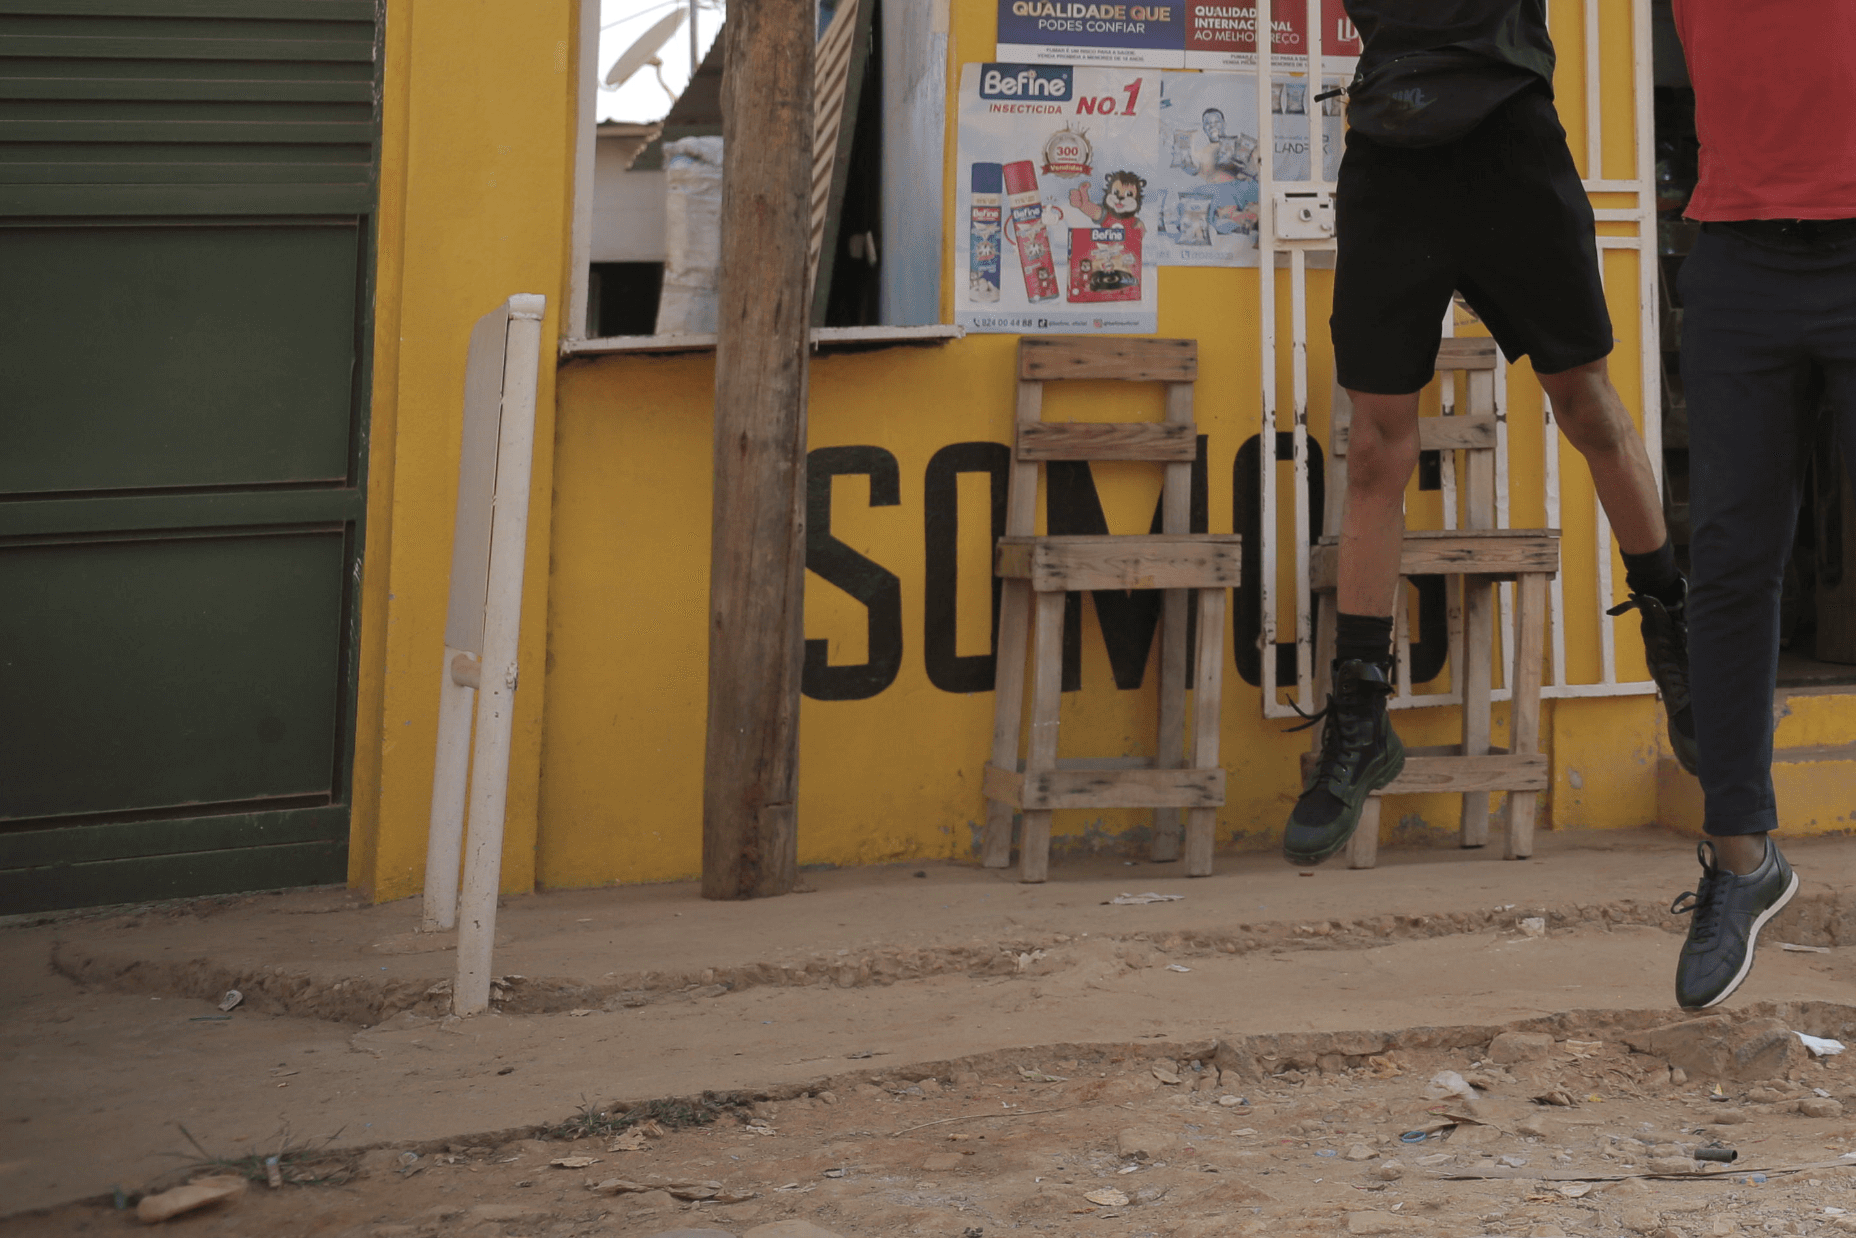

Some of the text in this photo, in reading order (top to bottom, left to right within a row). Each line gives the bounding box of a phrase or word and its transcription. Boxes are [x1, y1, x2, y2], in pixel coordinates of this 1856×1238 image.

[1012, 0, 1171, 22] QUALIDADE QUE
[1194, 5, 1258, 19] QUALIDAD
[1038, 18, 1146, 35] PODES CONFIAR
[1194, 17, 1293, 33] INTERNACNAL
[1193, 30, 1300, 45] AO MELHO REÇO
[983, 69, 1066, 97] Befine
[989, 103, 1063, 115] INSECTICIDA
[1056, 146, 1079, 157] 300
[1091, 228, 1124, 242] Befine
